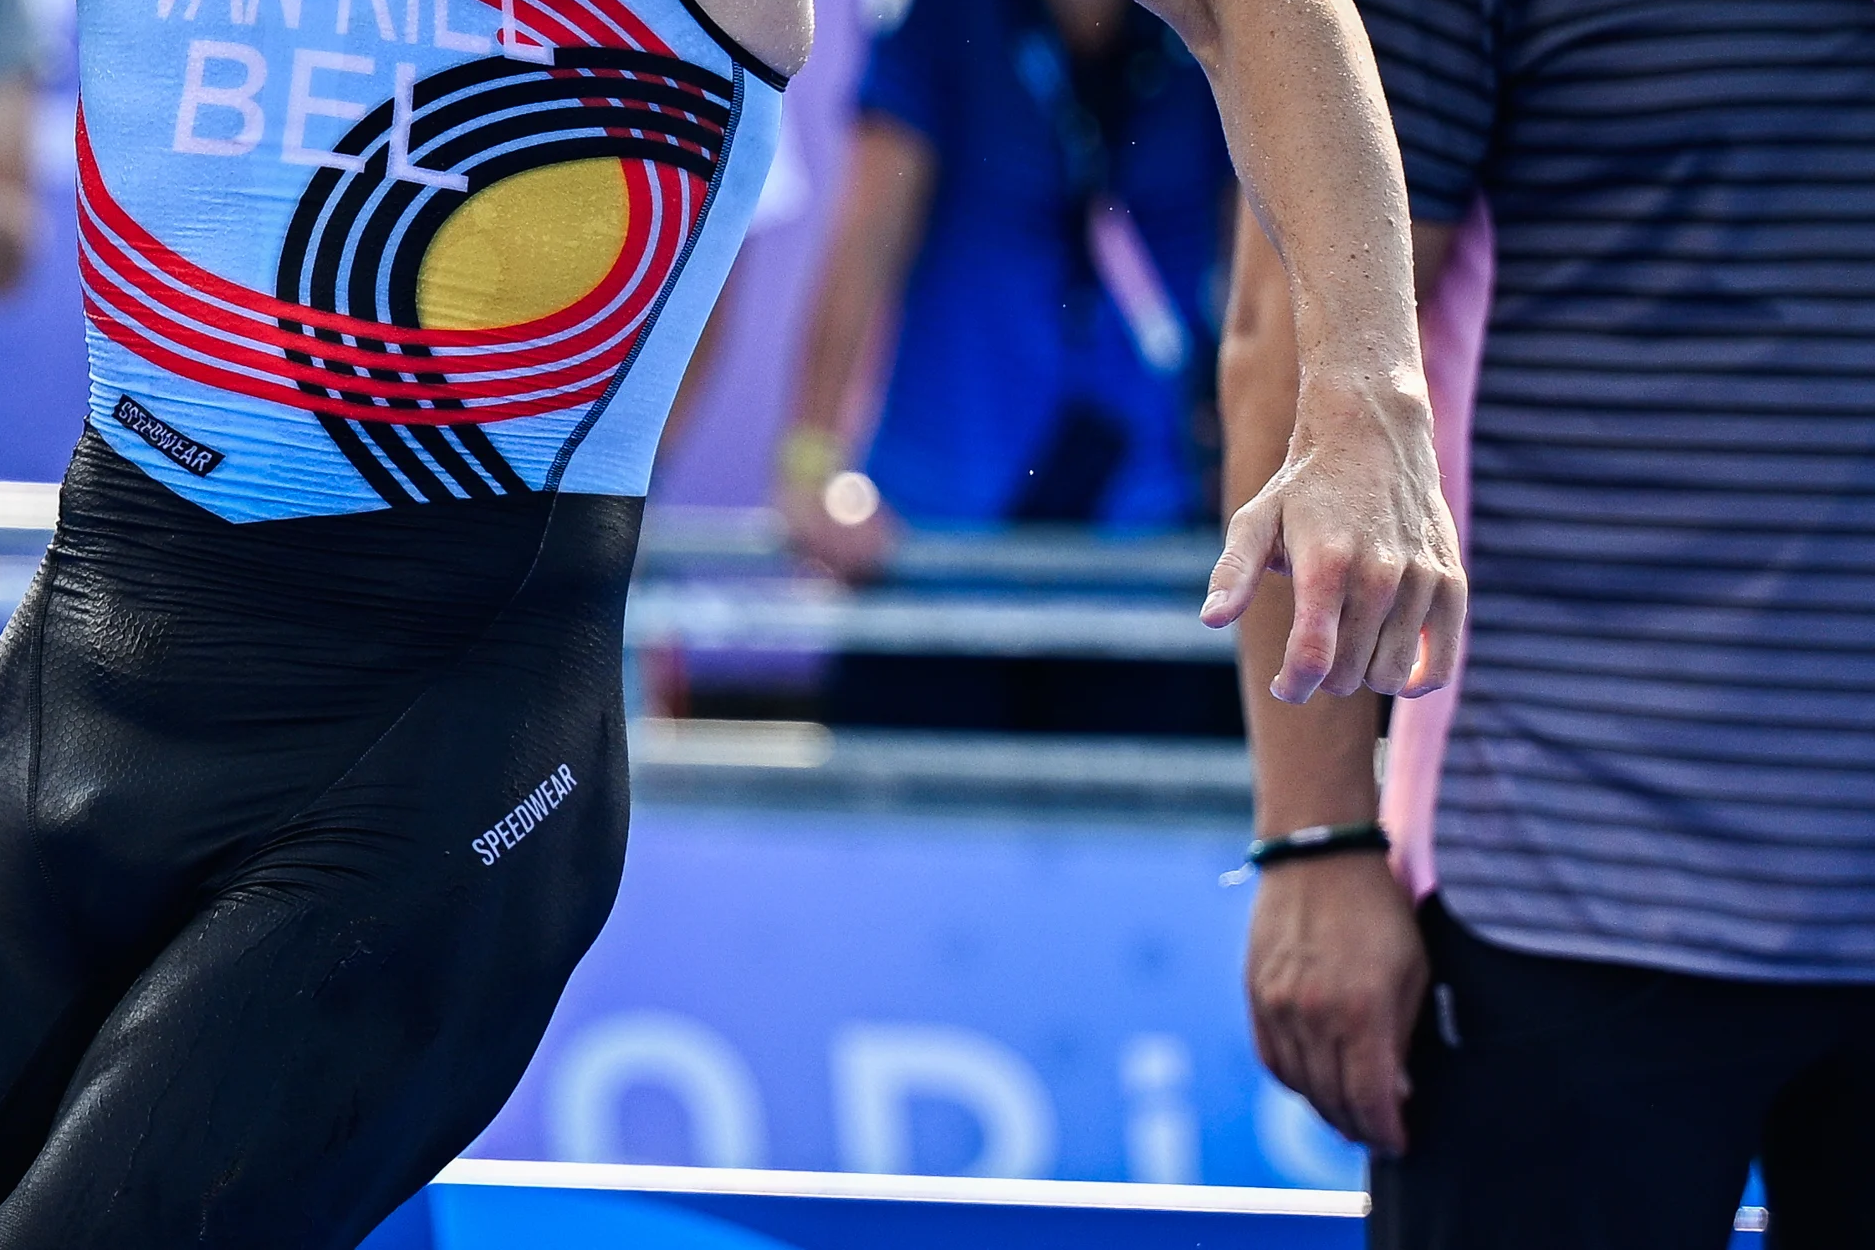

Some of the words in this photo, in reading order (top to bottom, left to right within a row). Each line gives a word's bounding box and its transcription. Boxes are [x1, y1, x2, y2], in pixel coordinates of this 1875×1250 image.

[171, 39, 469, 193] BEL
[118, 401, 213, 472] SPEEDWEAR
[471, 763, 578, 866] SPEEDWEAR
